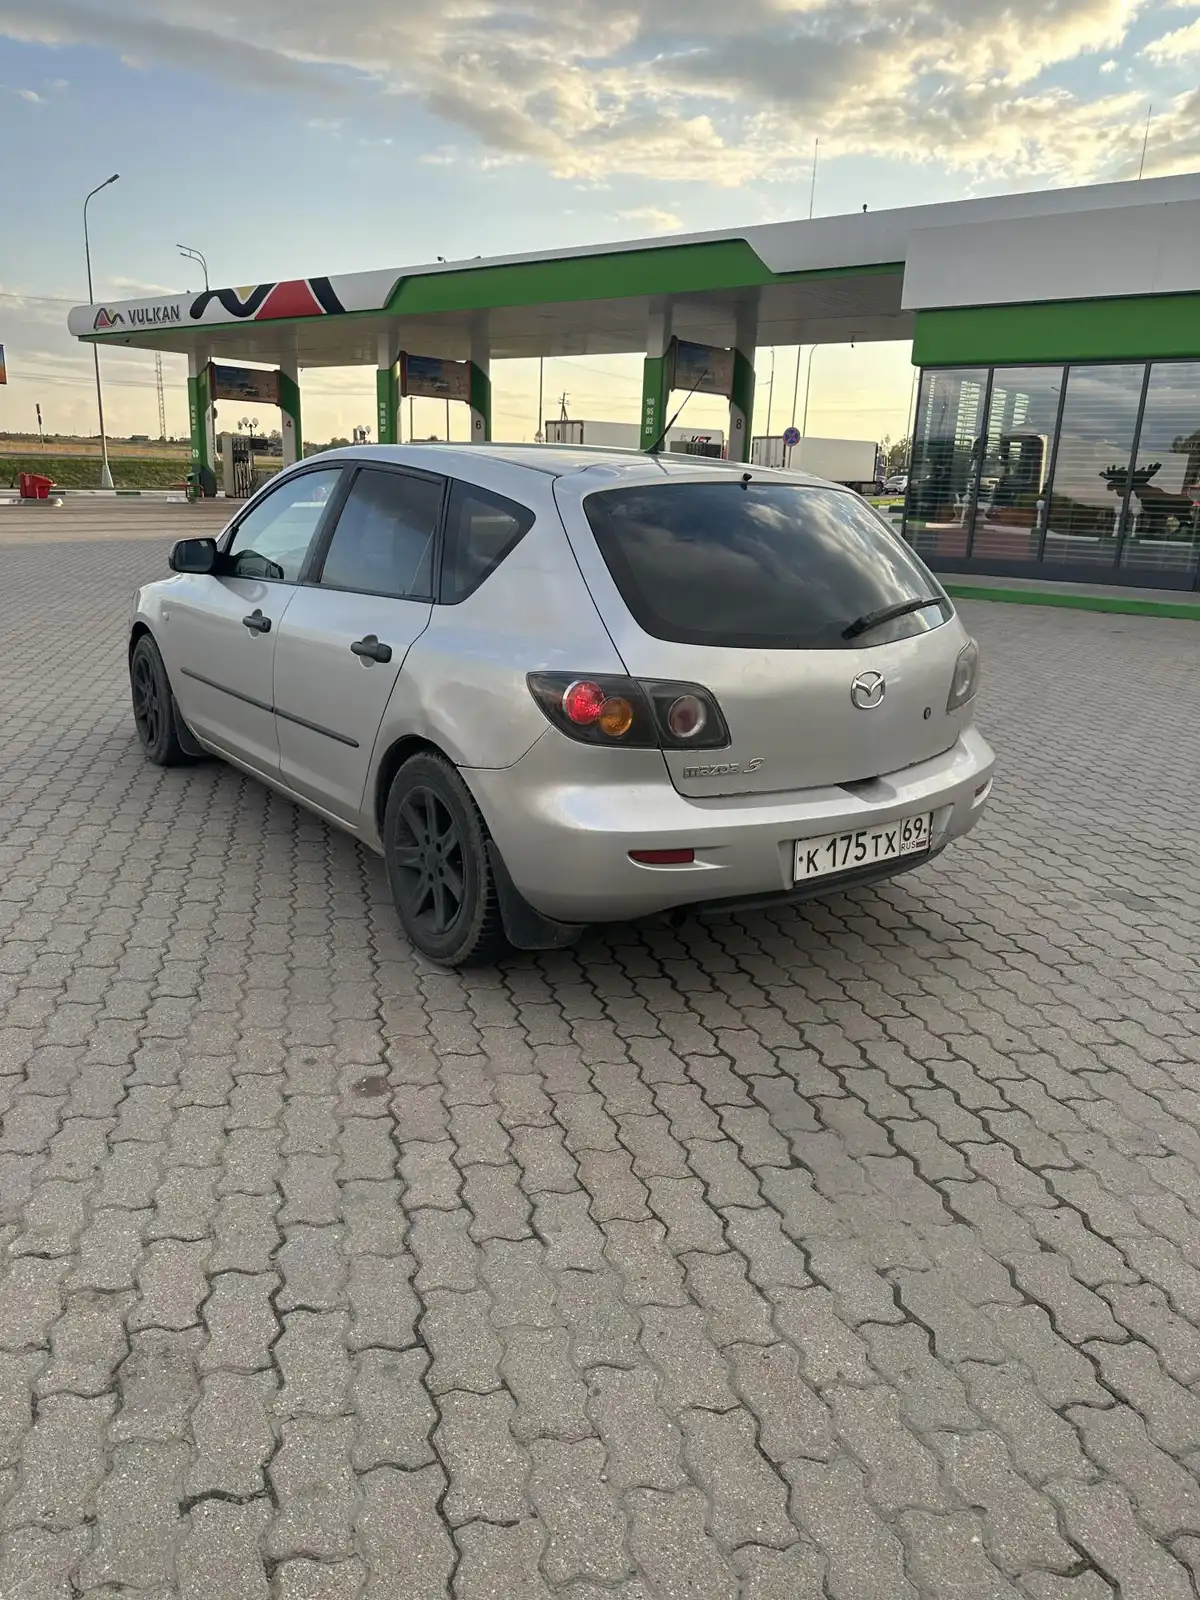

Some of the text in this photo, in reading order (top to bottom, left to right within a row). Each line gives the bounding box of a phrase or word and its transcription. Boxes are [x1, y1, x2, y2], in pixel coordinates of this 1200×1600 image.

[128, 304, 180, 324] VULKAN
[286, 419, 292, 429] 4
[475, 420, 482, 430] 6
[736, 418, 742, 430] 8
[742, 757, 765, 774] 3
[902, 817, 924, 842] 69
[901, 839, 916, 851] RUS
